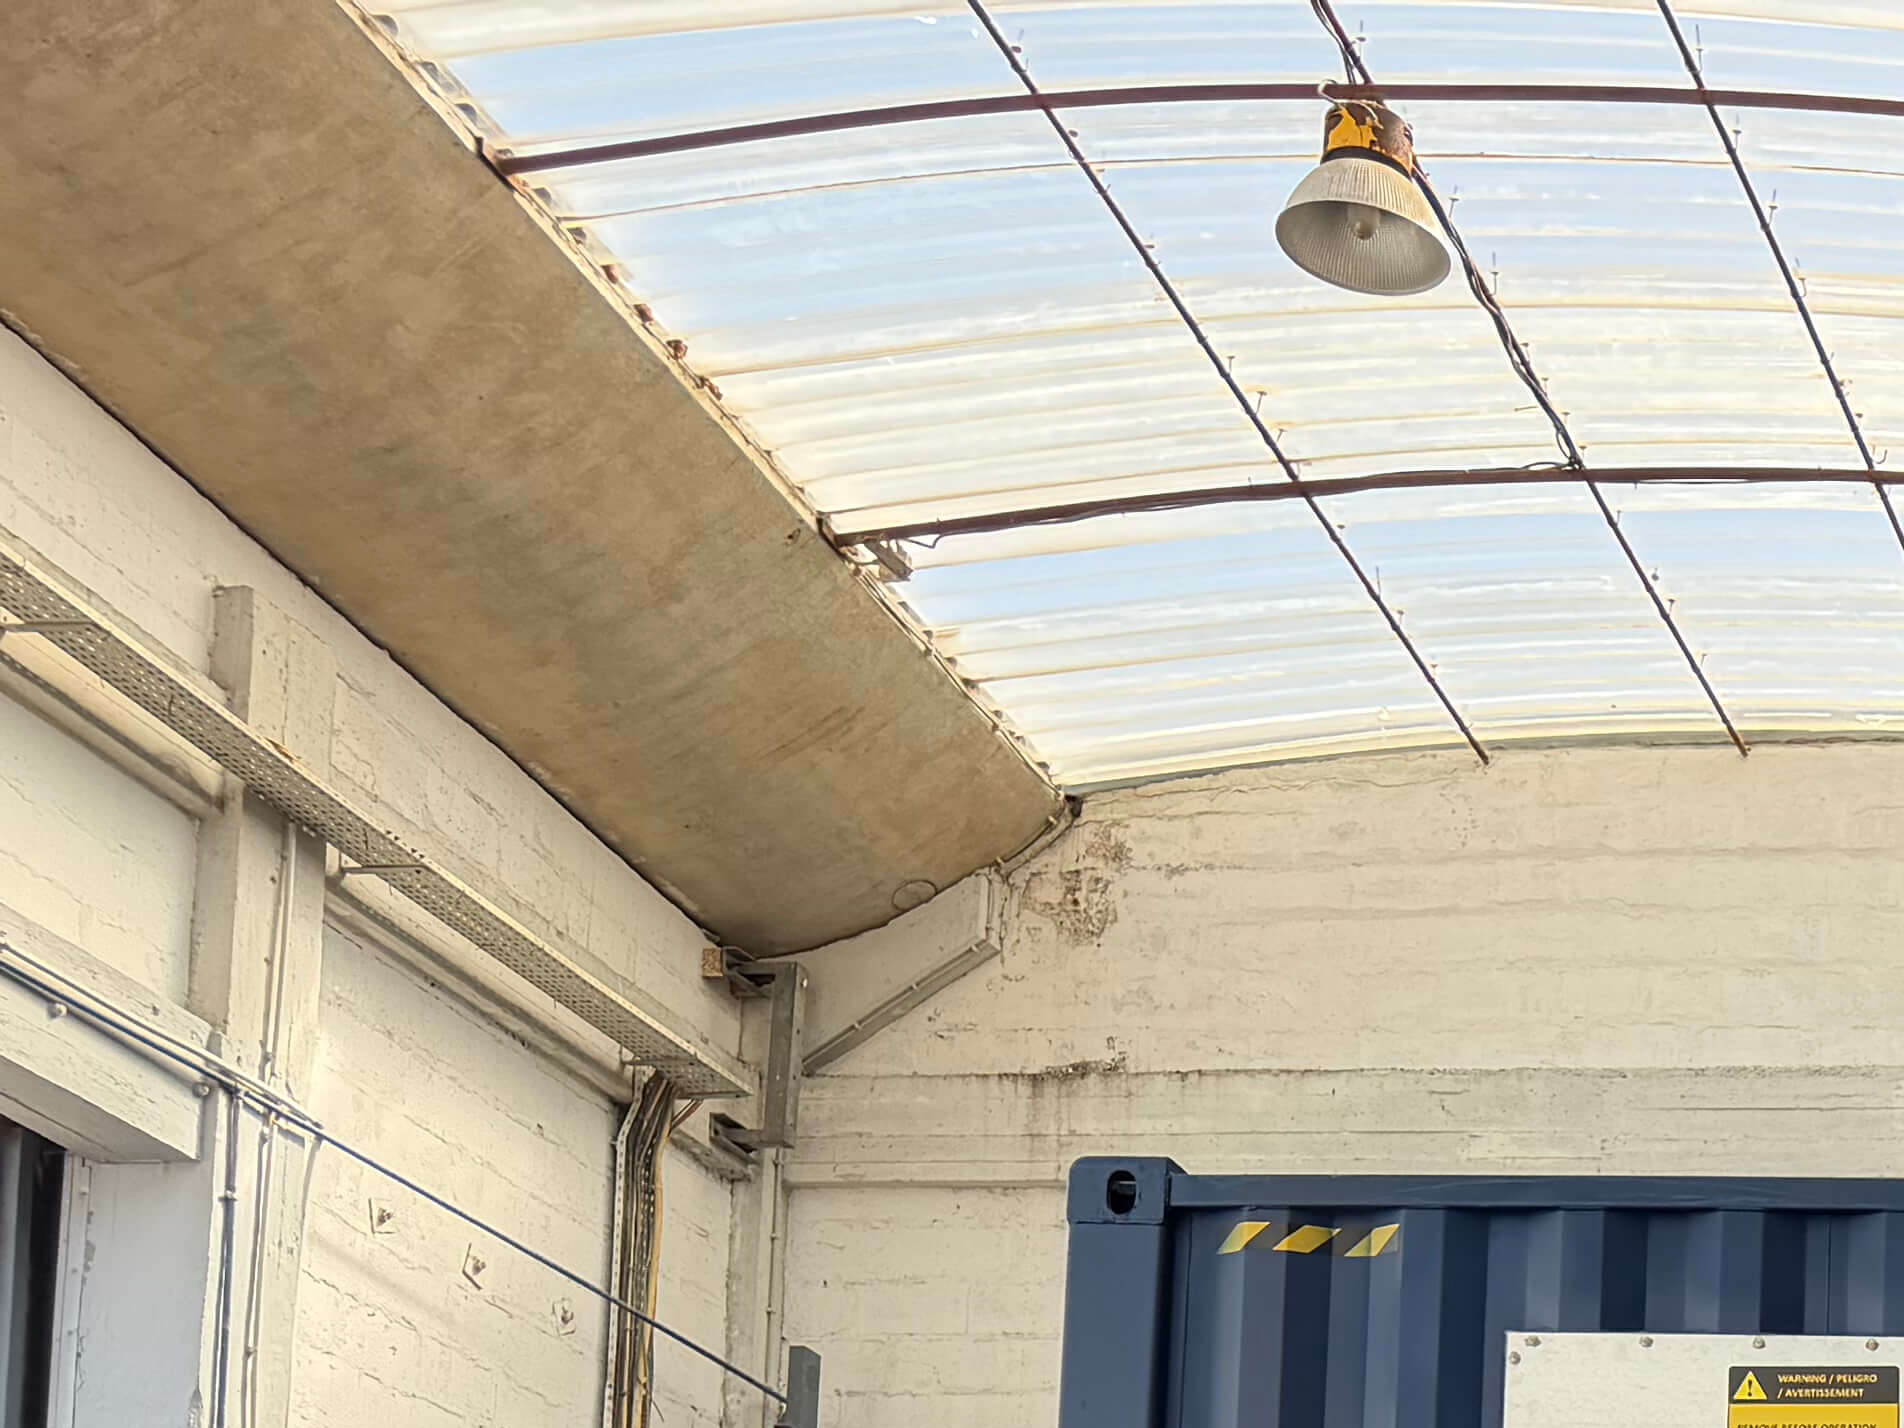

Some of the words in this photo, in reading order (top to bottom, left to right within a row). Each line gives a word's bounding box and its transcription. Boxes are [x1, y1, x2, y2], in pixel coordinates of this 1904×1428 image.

[1777, 1374, 1826, 1384] WARNING
[1836, 1374, 1878, 1384] PELIGRO
[1785, 1389, 1864, 1398] AVERTISSEMENT
